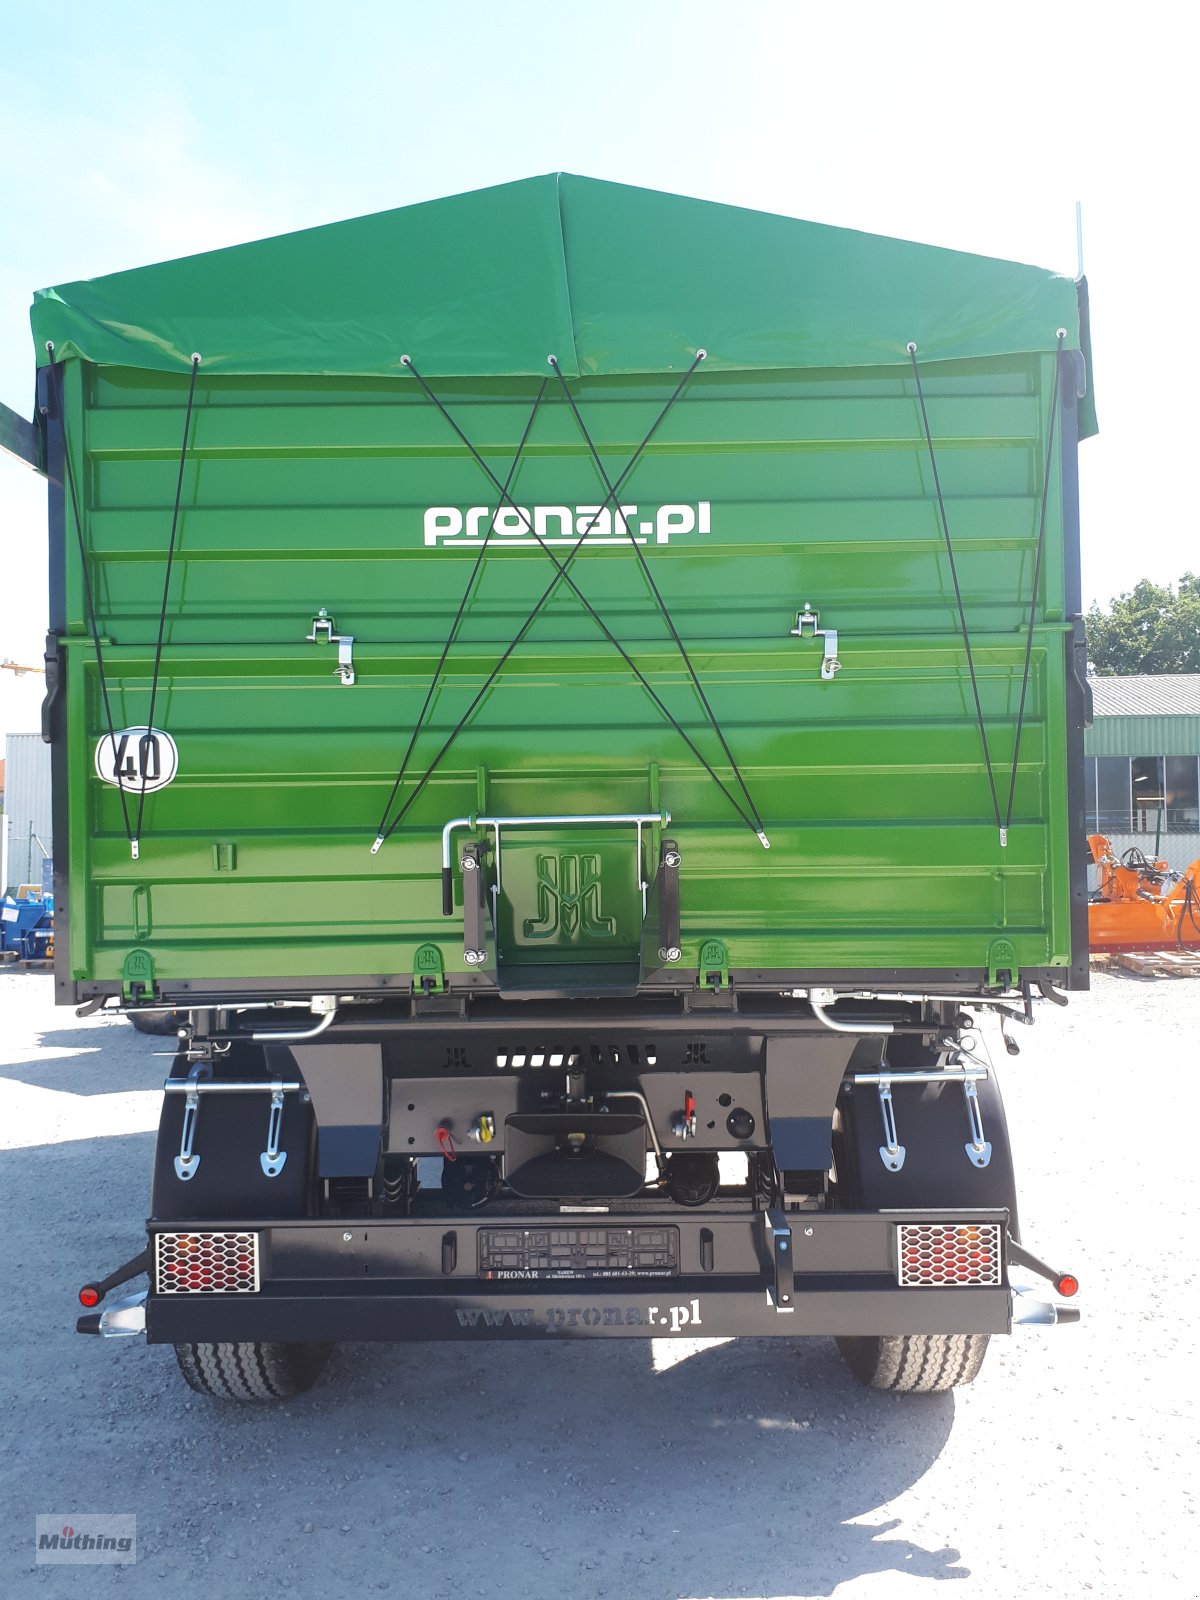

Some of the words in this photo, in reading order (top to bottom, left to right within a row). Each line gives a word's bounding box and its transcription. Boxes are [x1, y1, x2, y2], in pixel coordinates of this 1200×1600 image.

[424, 501, 711, 546] pronar.pl
[113, 735, 160, 781] 40
[497, 1270, 539, 1279] PRONAR
[455, 1299, 702, 1332] www.pronar.pl
